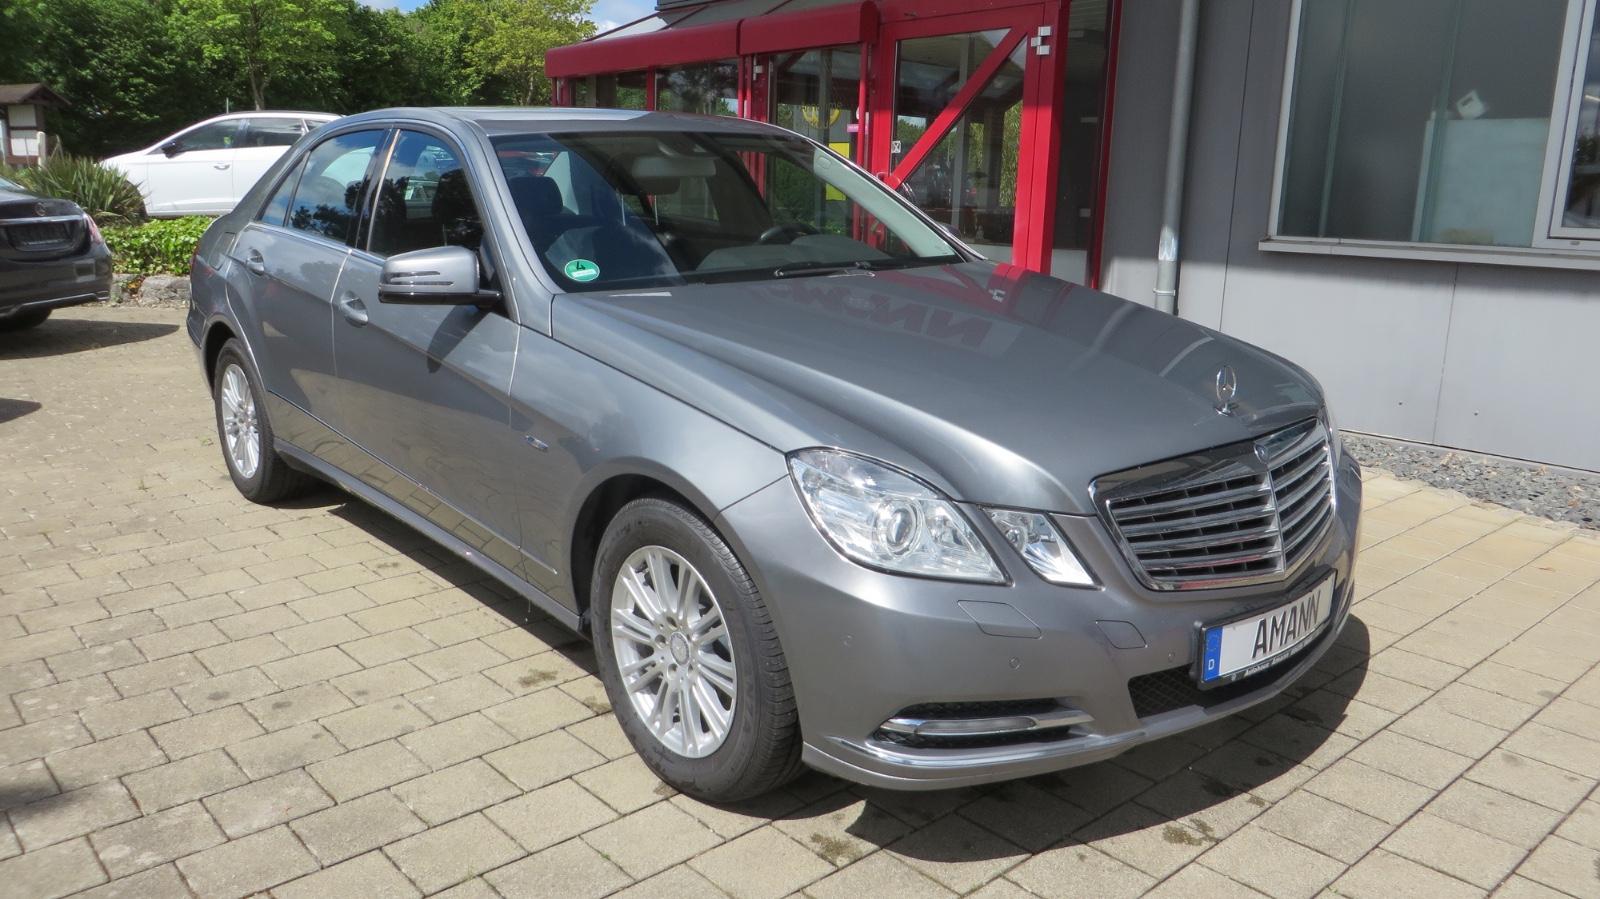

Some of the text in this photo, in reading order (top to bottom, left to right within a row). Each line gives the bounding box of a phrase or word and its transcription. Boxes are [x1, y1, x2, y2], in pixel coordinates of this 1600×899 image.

[576, 261, 586, 270] 4
[1252, 590, 1320, 659] AMANN
[1208, 659, 1215, 670] D
